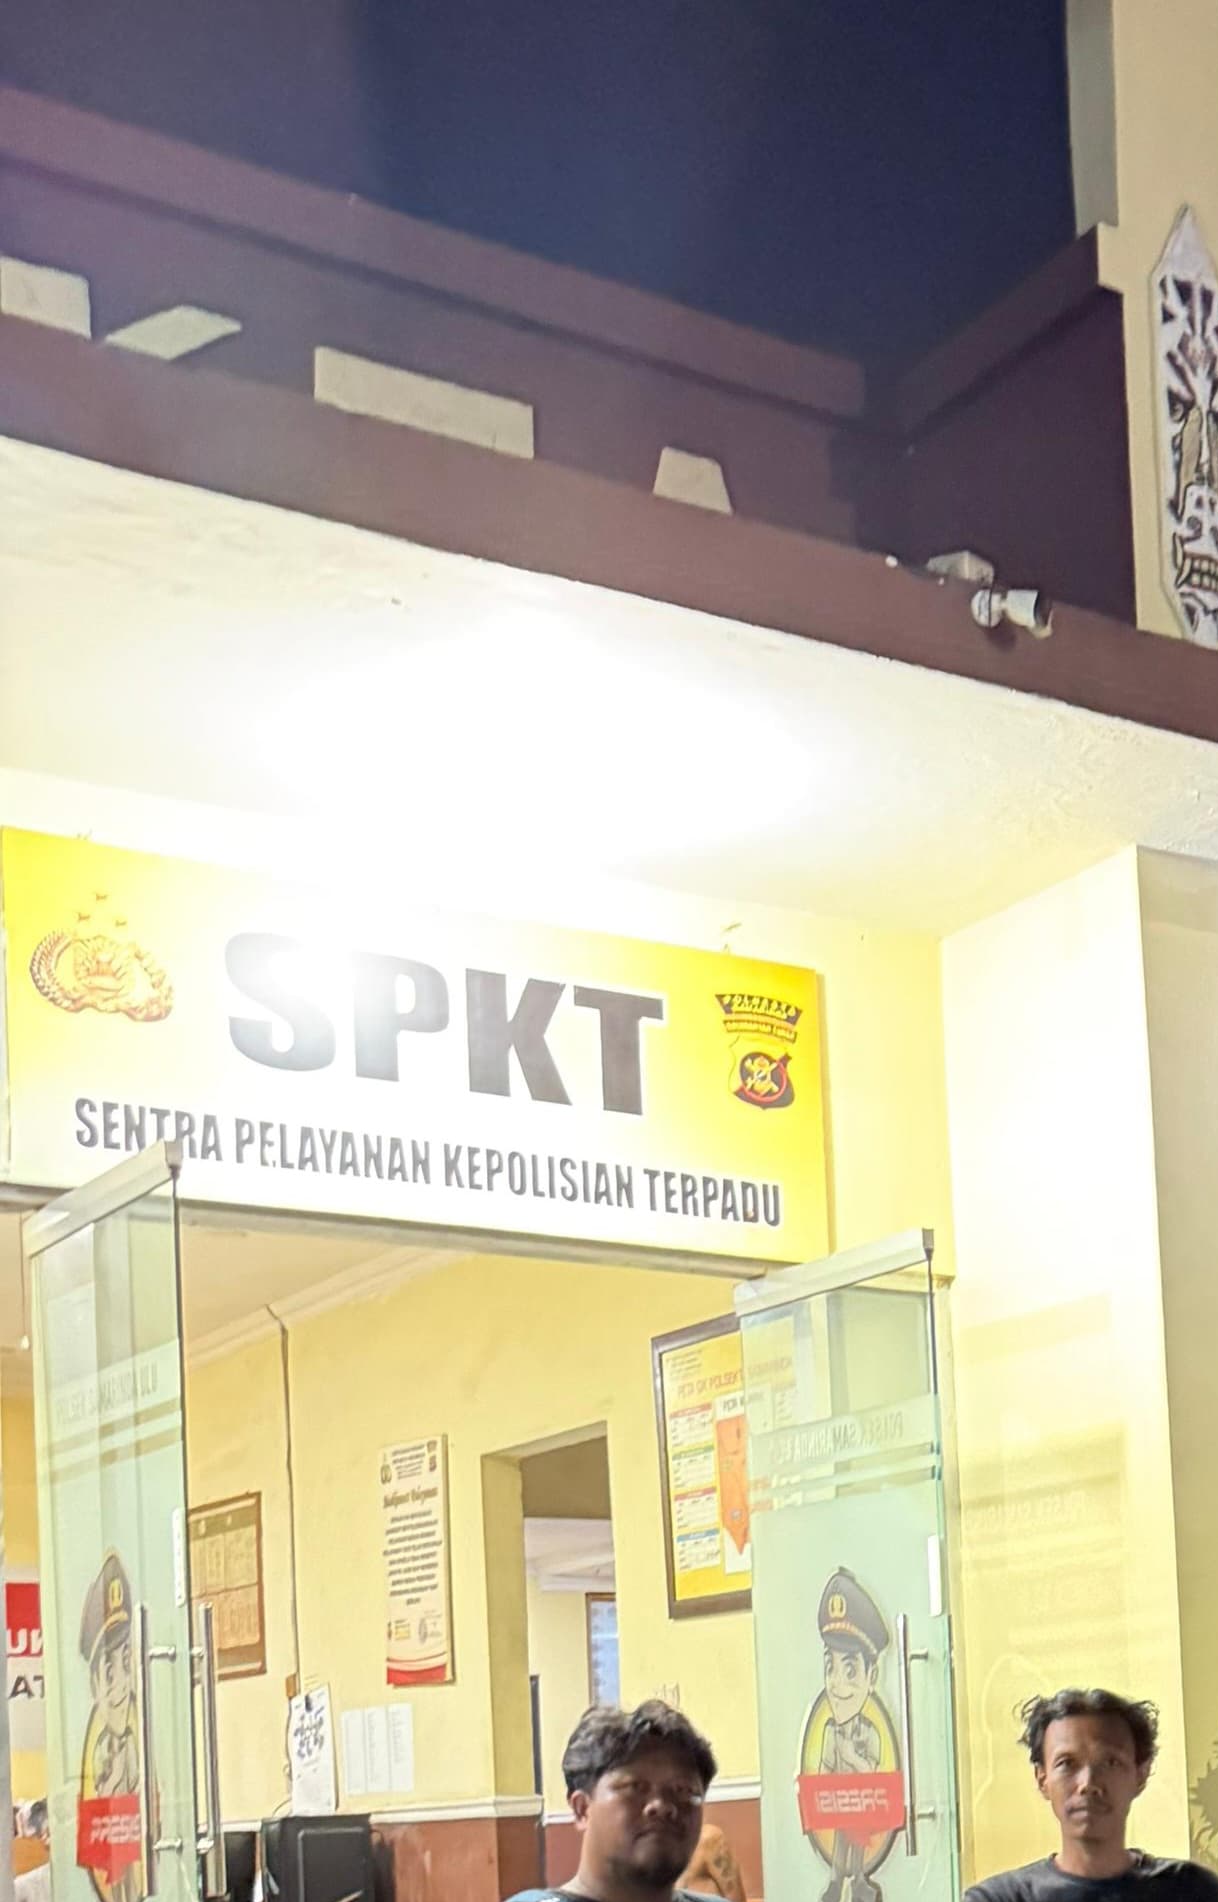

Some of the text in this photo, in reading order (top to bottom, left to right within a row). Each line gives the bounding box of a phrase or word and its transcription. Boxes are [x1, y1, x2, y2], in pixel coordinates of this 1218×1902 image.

[224, 930, 664, 1116] SPKT
[75, 1097, 782, 1228] SENTRA PELAYANAN KEPOLISIAN TERPADU
